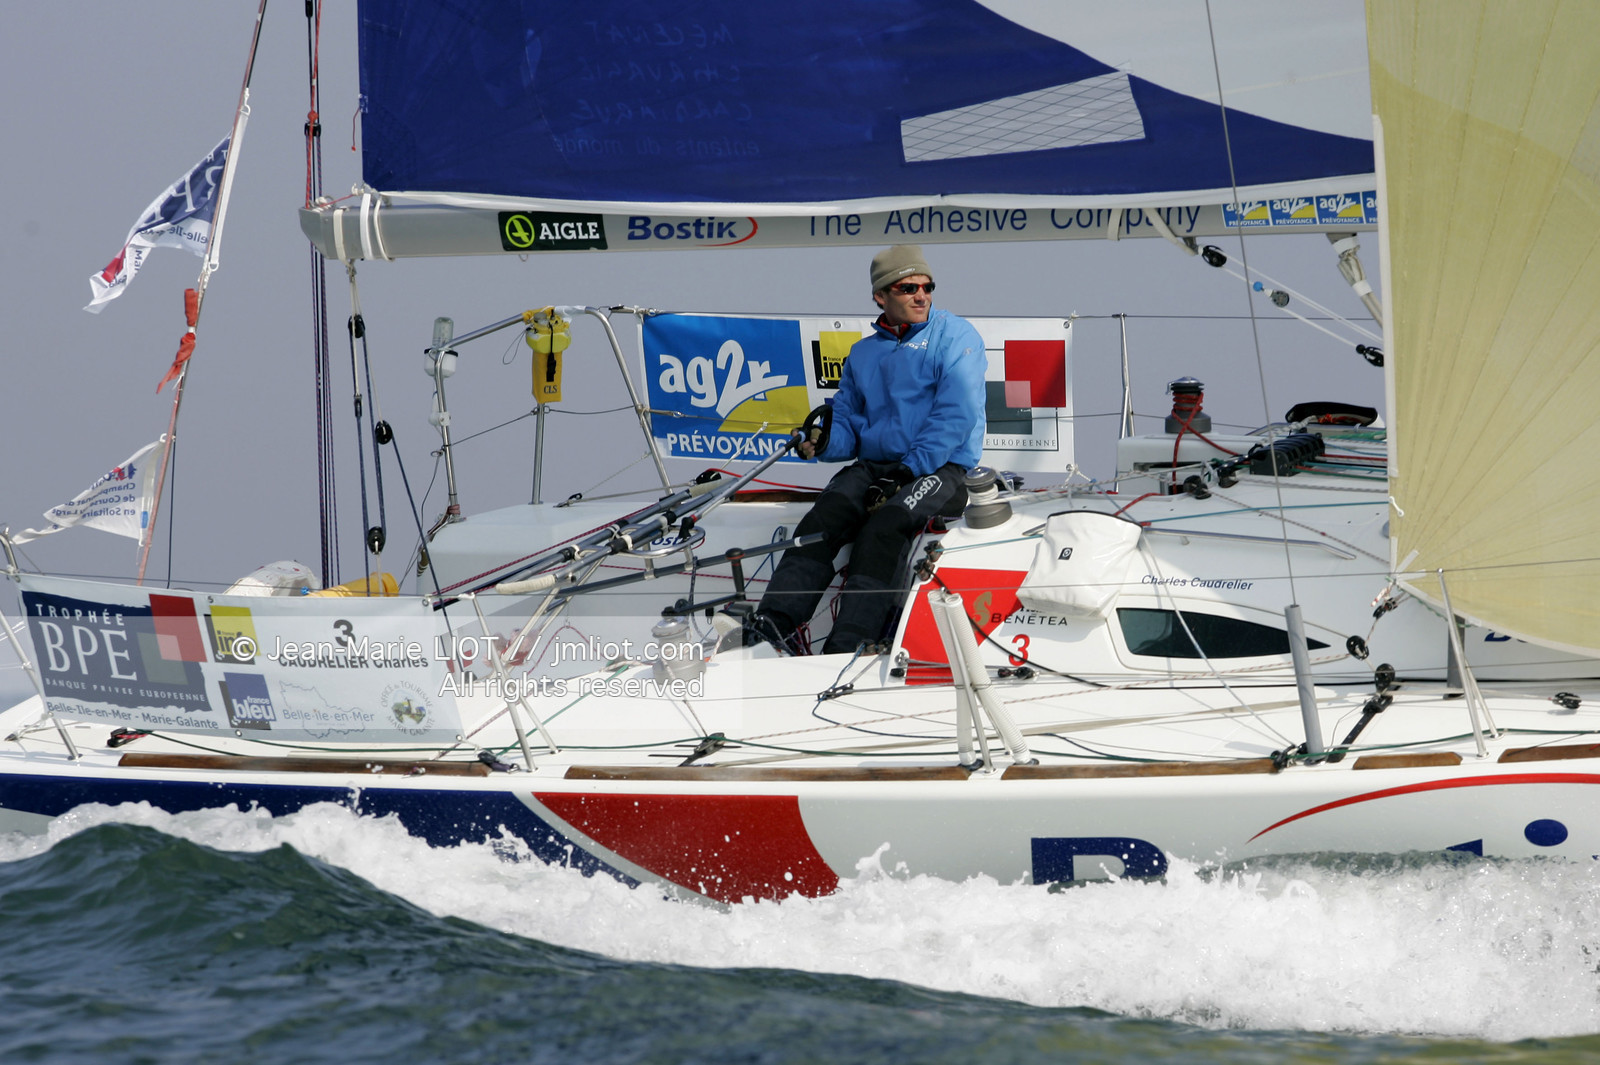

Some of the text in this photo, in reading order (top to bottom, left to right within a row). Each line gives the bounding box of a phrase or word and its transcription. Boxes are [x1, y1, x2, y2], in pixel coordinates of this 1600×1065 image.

[539, 221, 600, 240] AIGLE
[627, 216, 737, 240] Bostik
[884, 206, 1028, 234] Adhesive
[543, 385, 558, 394] CLS
[659, 339, 789, 419] ag2r
[1141, 575, 1254, 590] Charles Caudrelier
[35, 604, 125, 626] TROPHÉE
[333, 619, 356, 647] 3
[38, 621, 138, 681] BPE
[1008, 633, 1030, 667] 3
[45, 678, 206, 702] BANQUE PRIVEE EUROPEENNE
[47, 702, 133, 721] Belle-Ile-en-Mer
[142, 713, 219, 729] Marie-Galante
[232, 699, 275, 720] bleu
